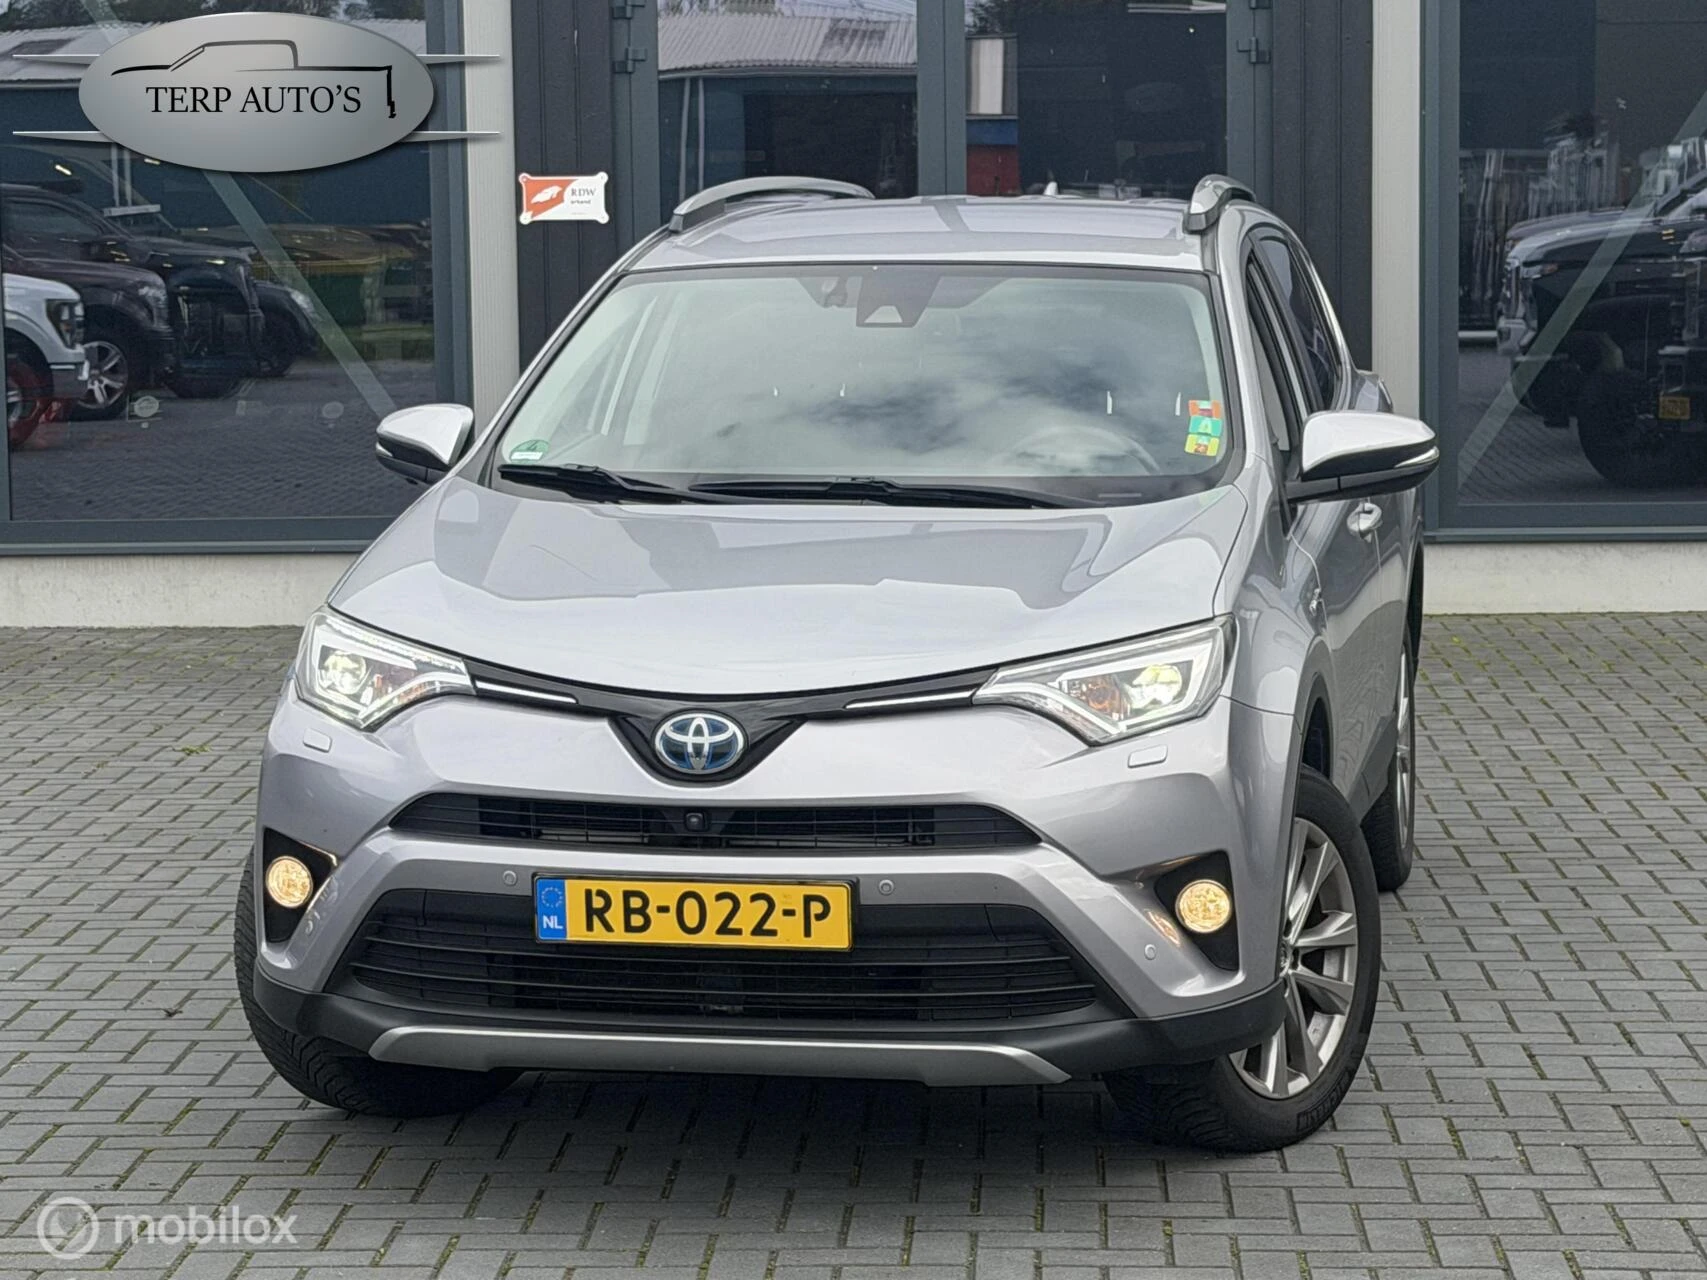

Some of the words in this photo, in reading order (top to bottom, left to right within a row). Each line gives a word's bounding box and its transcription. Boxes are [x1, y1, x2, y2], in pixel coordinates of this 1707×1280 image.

[570, 187, 597, 197] RDW
[584, 888, 831, 938] RB-022-P
[543, 914, 563, 930] NL
